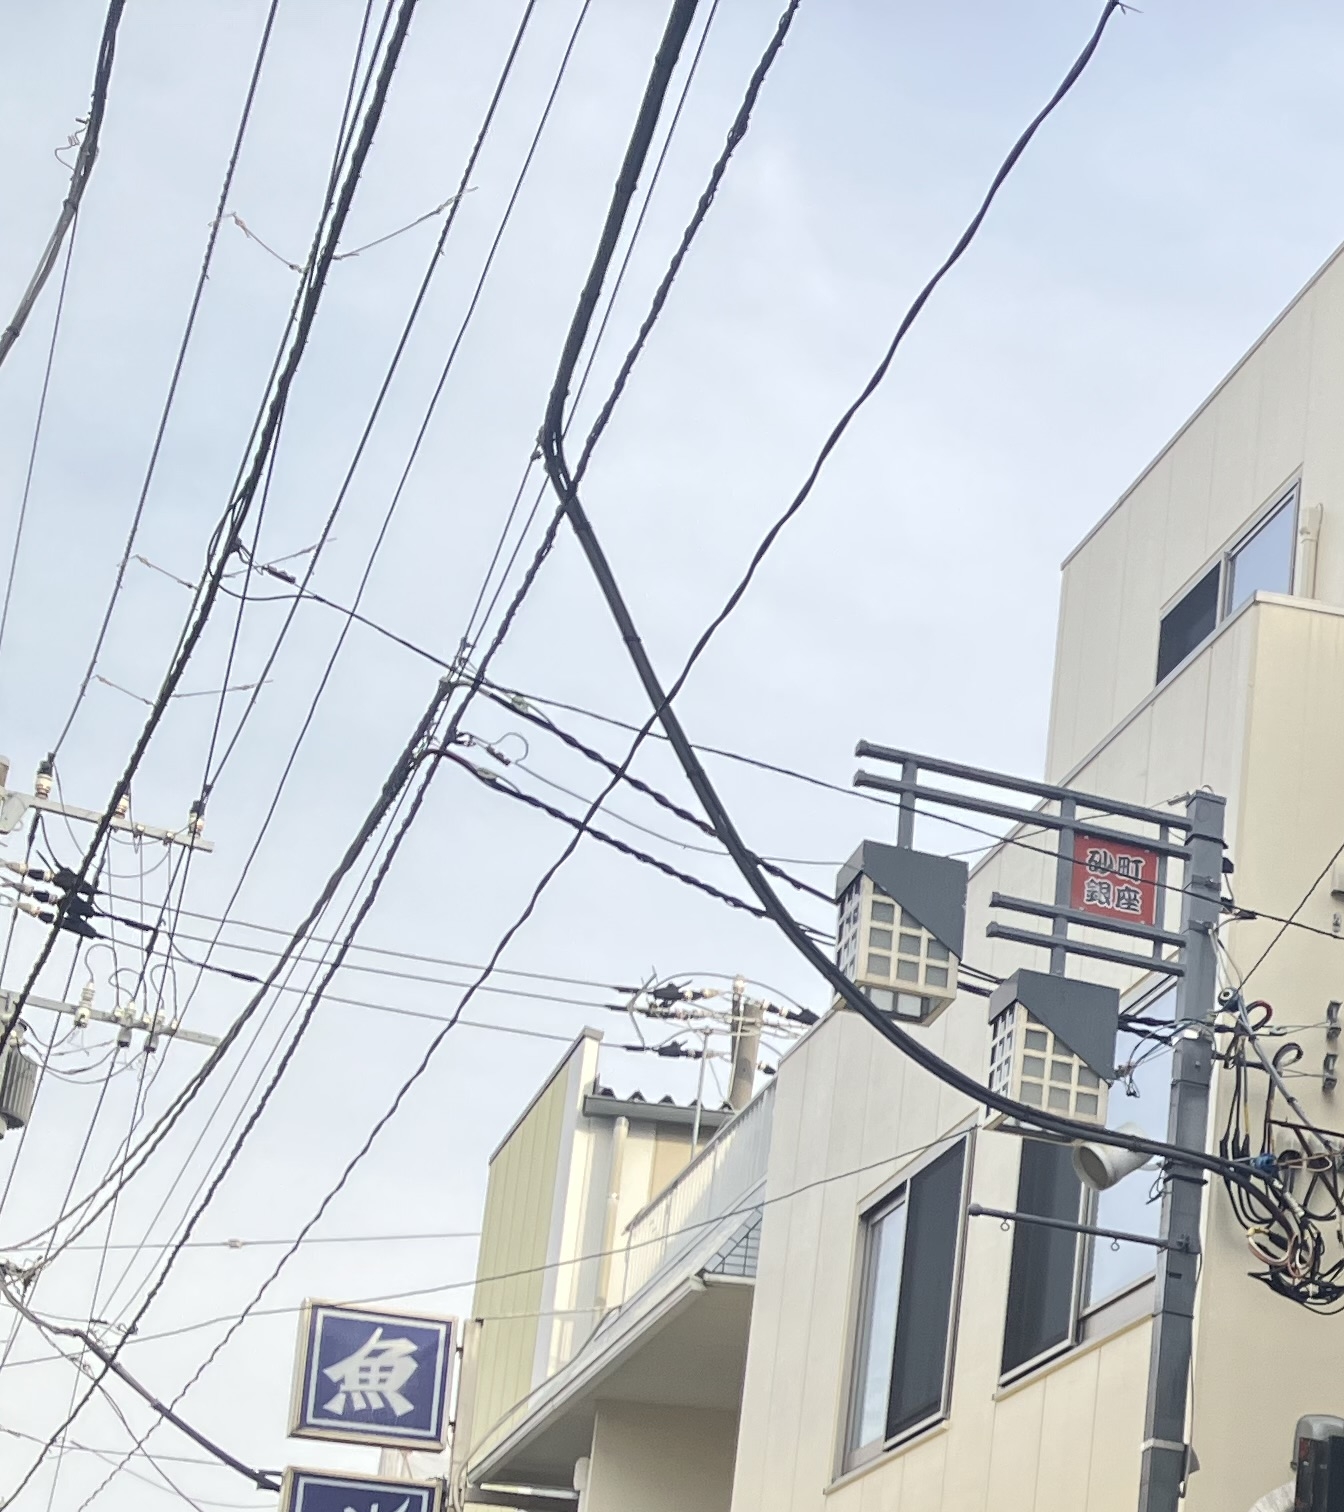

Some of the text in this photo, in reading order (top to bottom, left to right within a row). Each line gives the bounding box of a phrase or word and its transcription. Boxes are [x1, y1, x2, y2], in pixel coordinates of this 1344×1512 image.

[1086, 848, 1146, 885] 砂町
[1084, 876, 1142, 914] 銀座
[322, 1326, 419, 1418] 魚
